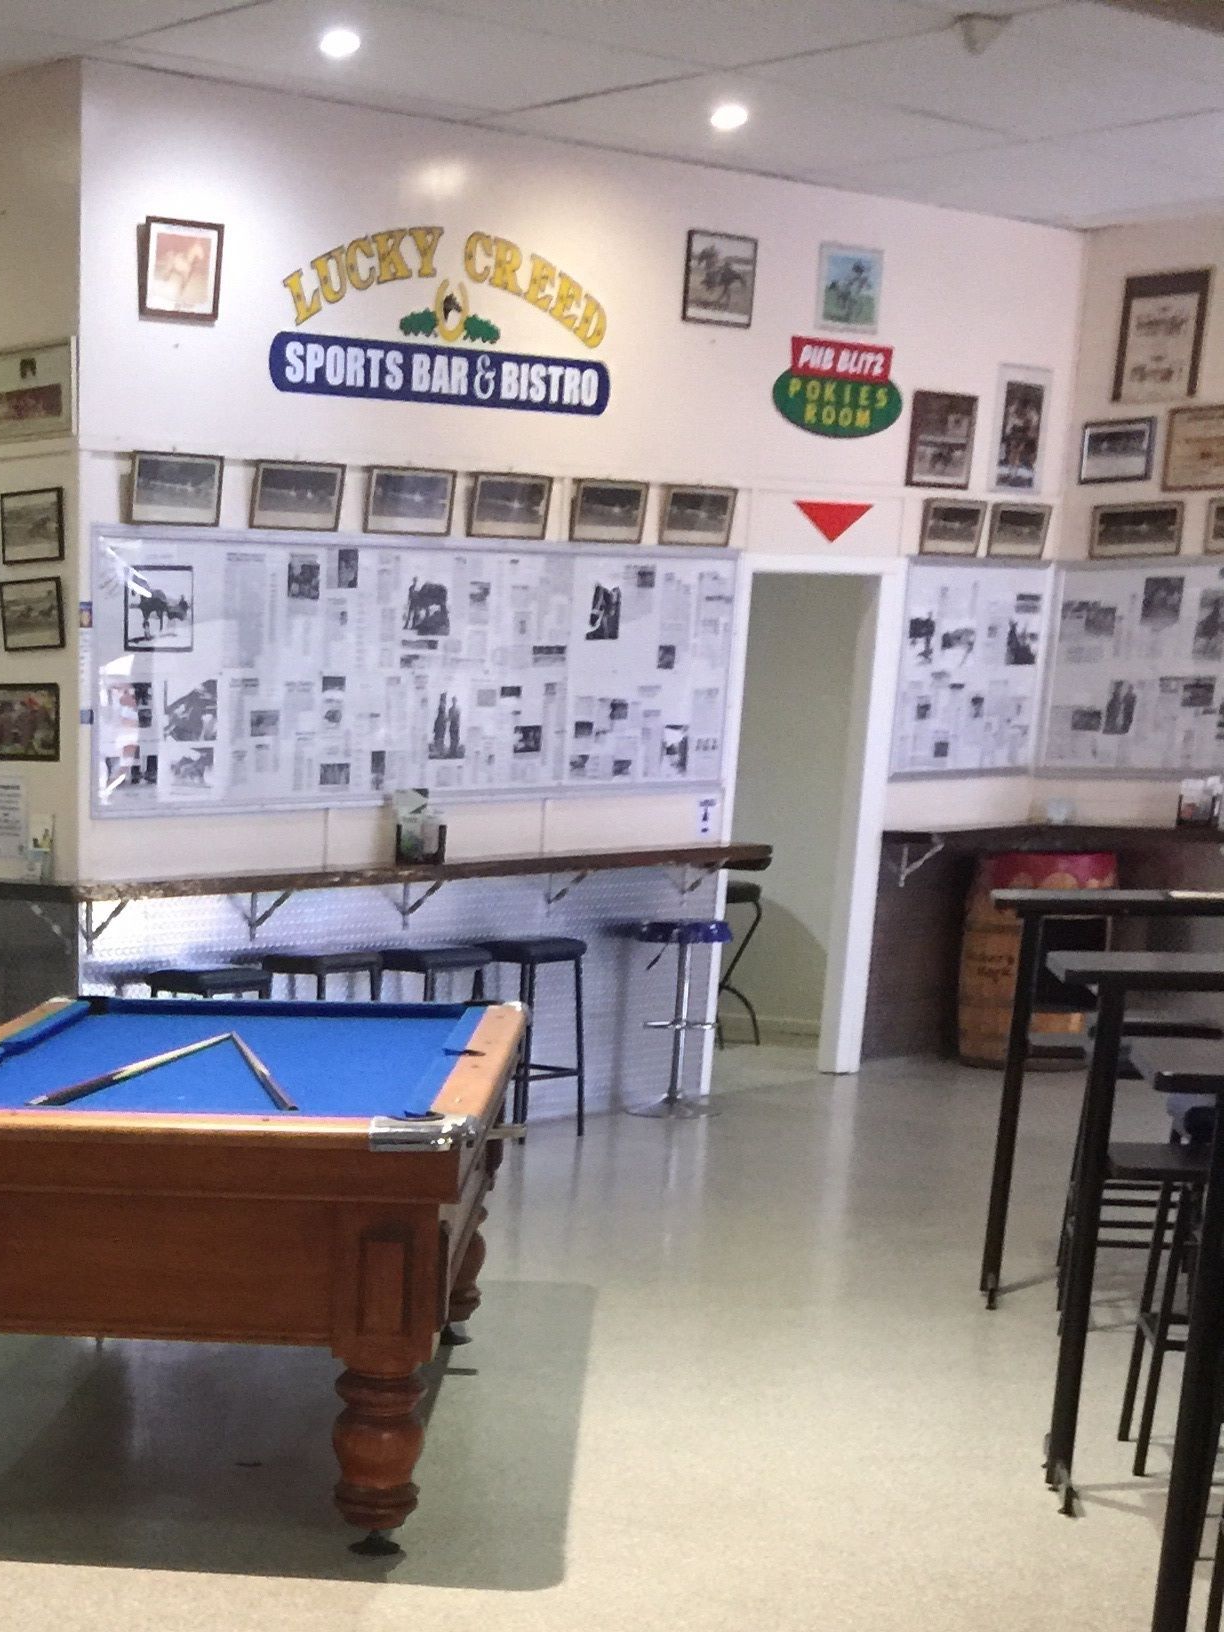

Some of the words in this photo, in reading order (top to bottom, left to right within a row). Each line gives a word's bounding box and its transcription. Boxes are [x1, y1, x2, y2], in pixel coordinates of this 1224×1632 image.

[282, 225, 445, 327] LUCKY
[463, 230, 608, 349] CREED
[284, 340, 405, 391] SPORTS
[410, 352, 469, 396] BAR
[474, 354, 496, 400] &
[501, 361, 599, 408] BISTRO
[798, 344, 835, 371] PUB
[836, 347, 885, 377] BLITZ
[788, 377, 889, 409] POKIES
[804, 402, 871, 428] ROOM
